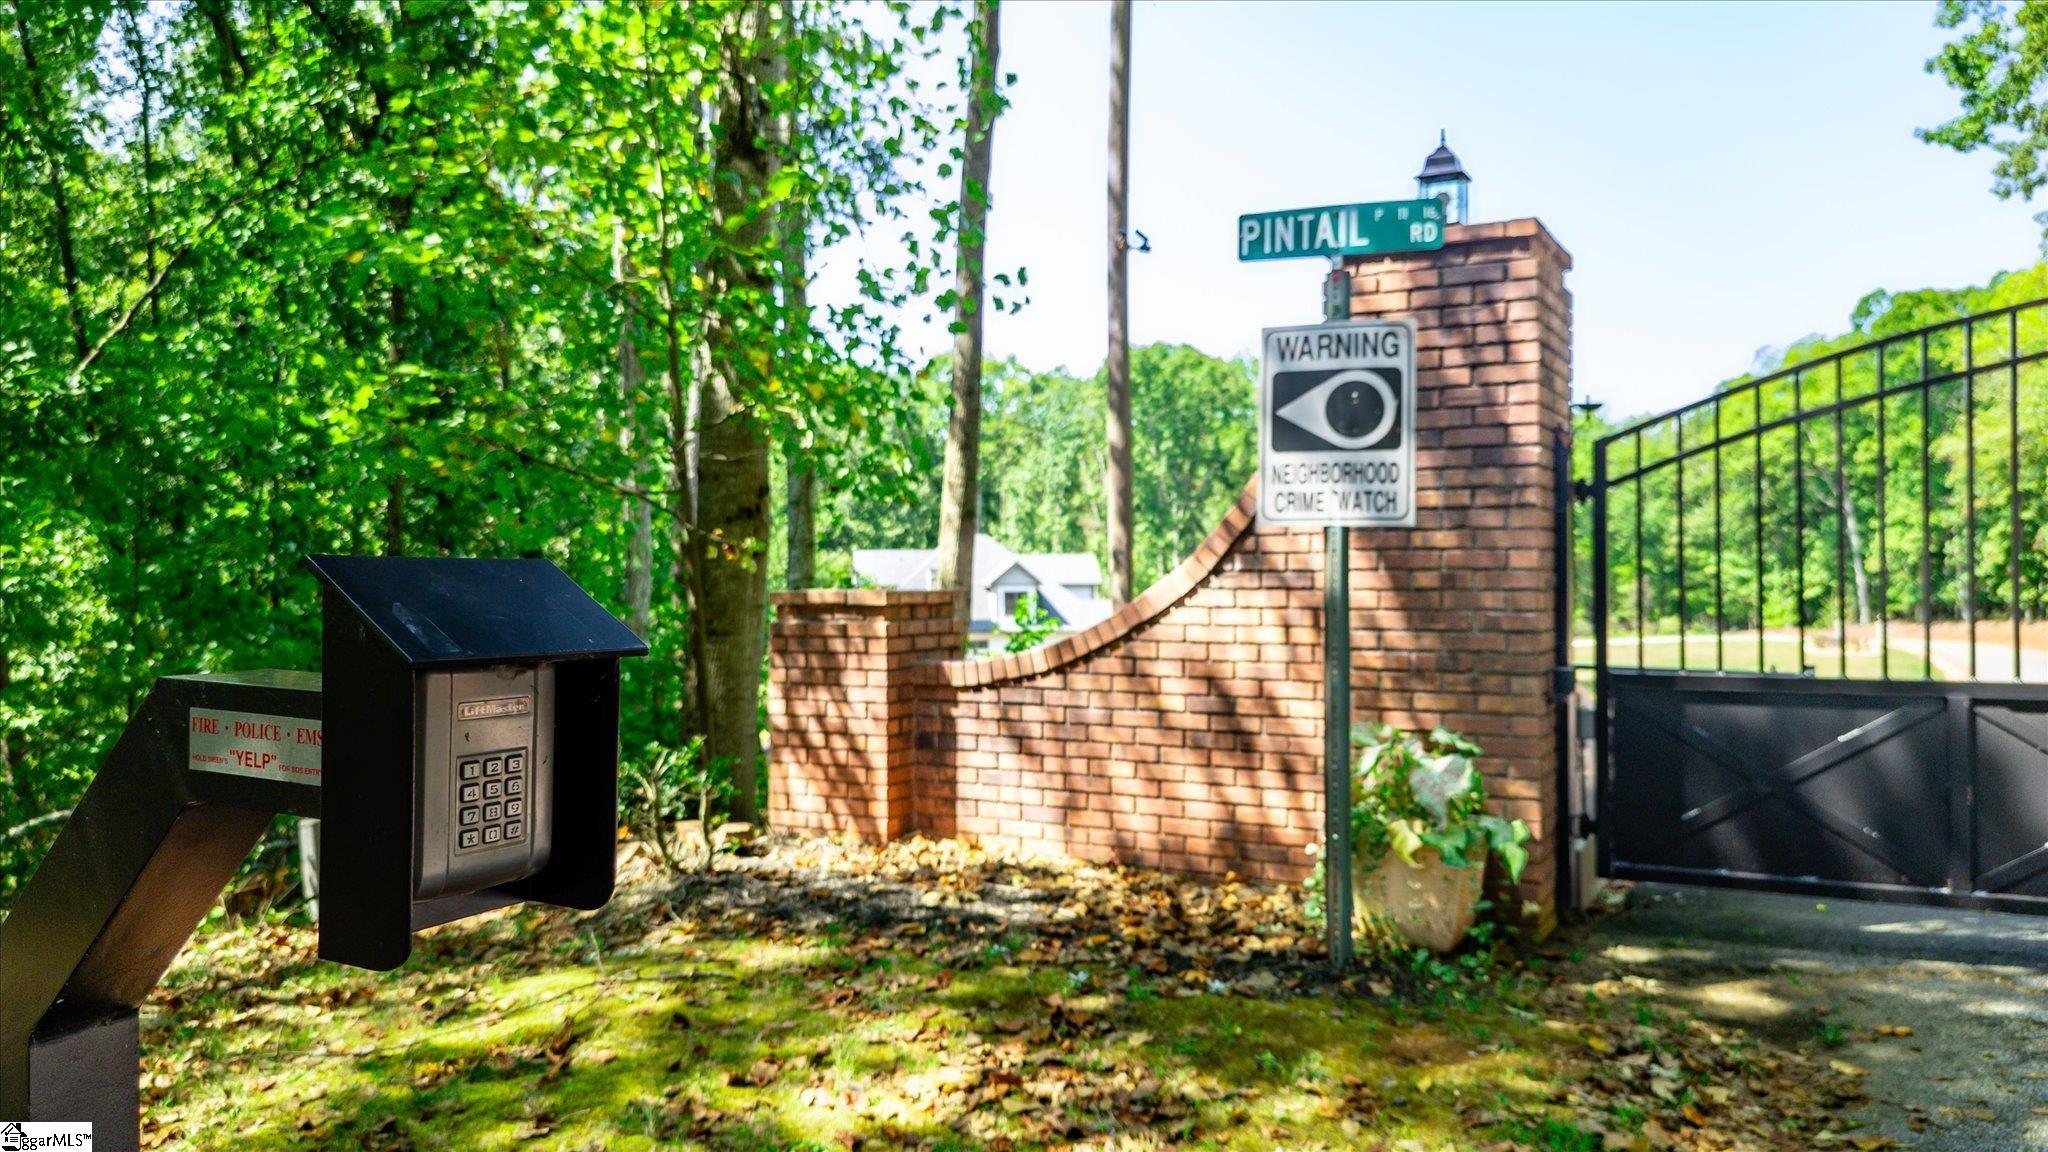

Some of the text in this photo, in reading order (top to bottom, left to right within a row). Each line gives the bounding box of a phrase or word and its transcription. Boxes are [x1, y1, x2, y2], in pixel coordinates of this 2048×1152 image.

[1241, 209, 1369, 256] PINTAIL
[1410, 220, 1438, 243] RD
[1276, 331, 1400, 362] WARNING
[1271, 462, 1400, 485] NEIGHBORHOOD
[1274, 491, 1398, 513] CRIME WATCH
[464, 702, 524, 717] LiftMaster
[191, 717, 219, 735] FIRE
[234, 721, 281, 741] POLICE
[278, 764, 290, 772] FOR
[469, 760, 520, 775] 1 2 3
[467, 782, 519, 798] 4 5 6
[467, 803, 519, 821] 7 8 9
